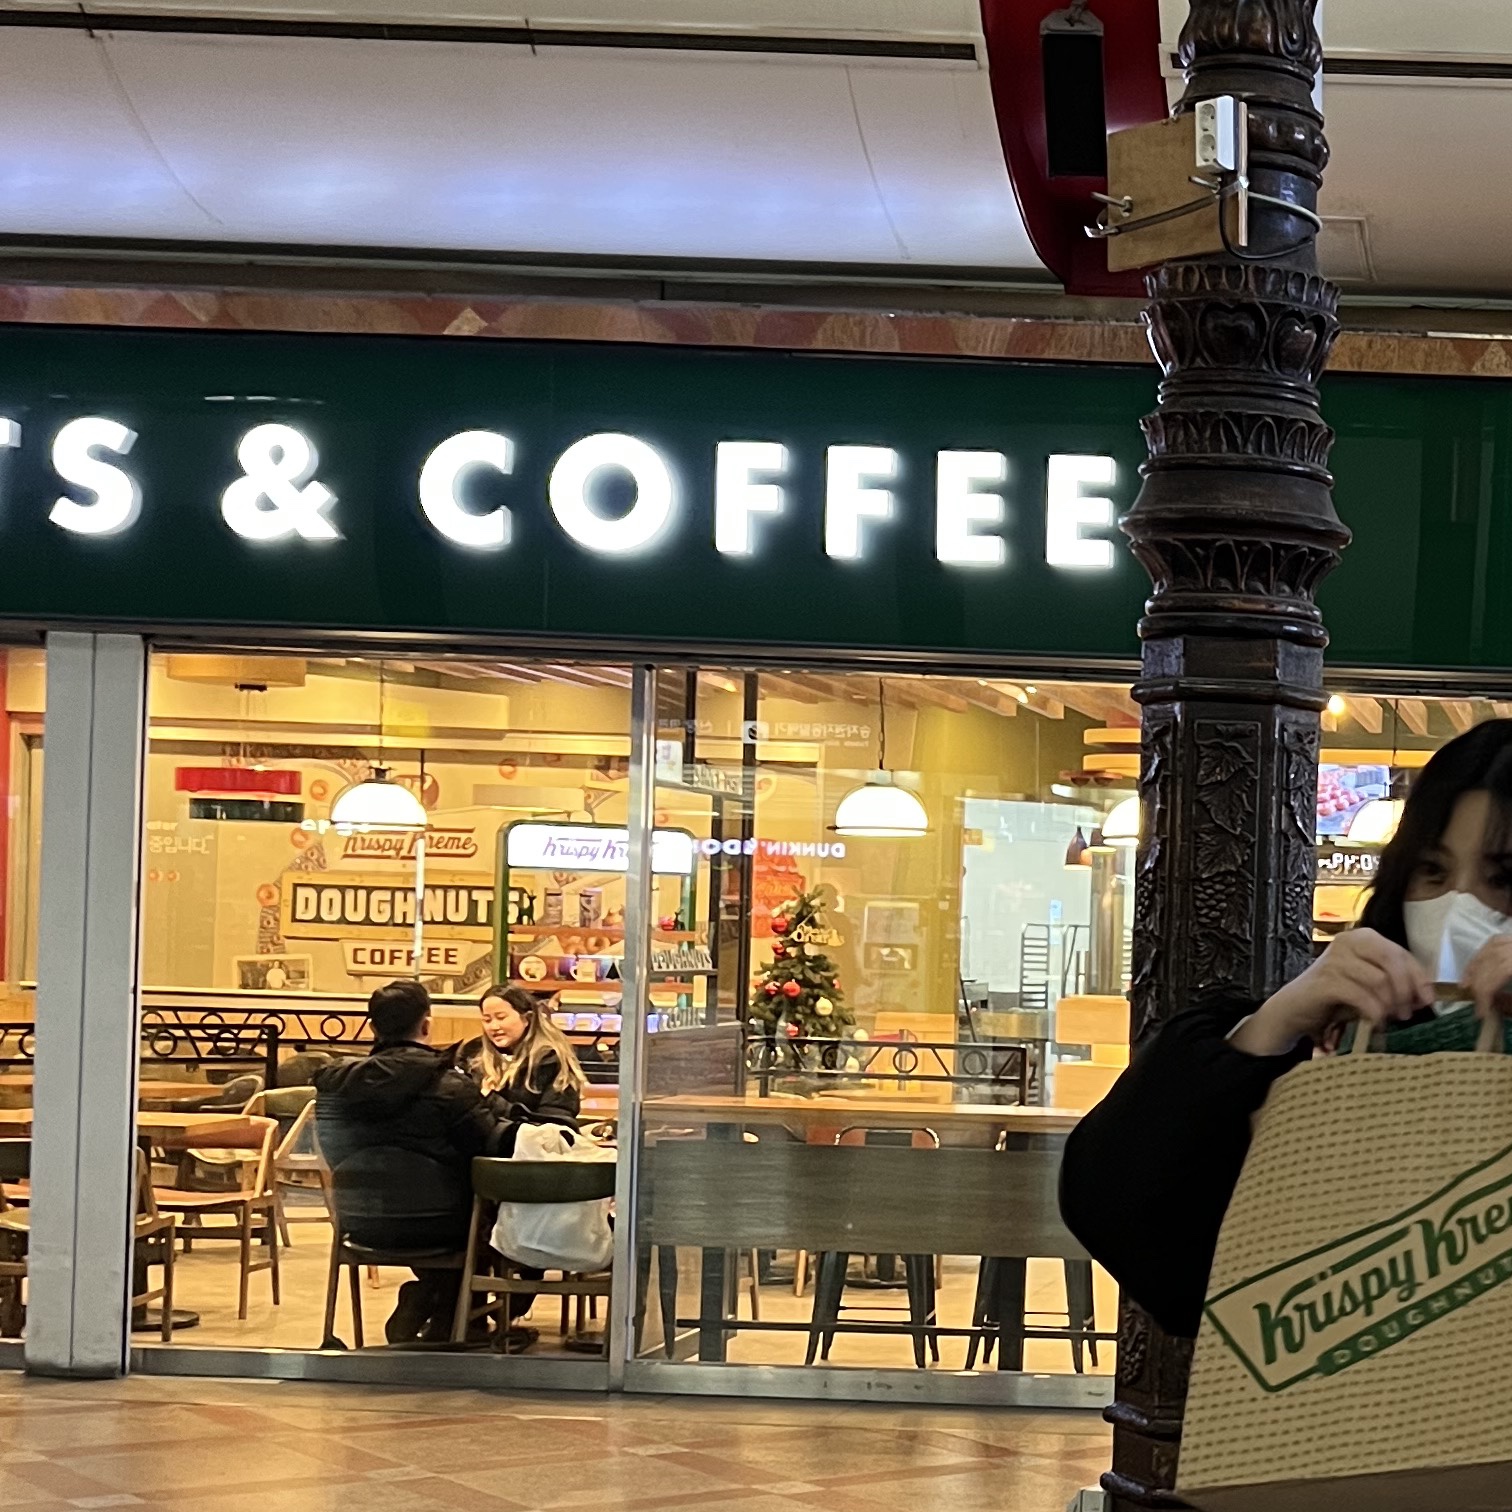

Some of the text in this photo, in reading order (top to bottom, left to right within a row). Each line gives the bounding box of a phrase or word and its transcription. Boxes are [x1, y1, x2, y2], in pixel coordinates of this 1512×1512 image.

[221, 423, 345, 541] &
[418, 427, 1117, 570] COFFEE
[352, 947, 458, 966] COFFEE
[1252, 1225, 1422, 1366] Krispy
